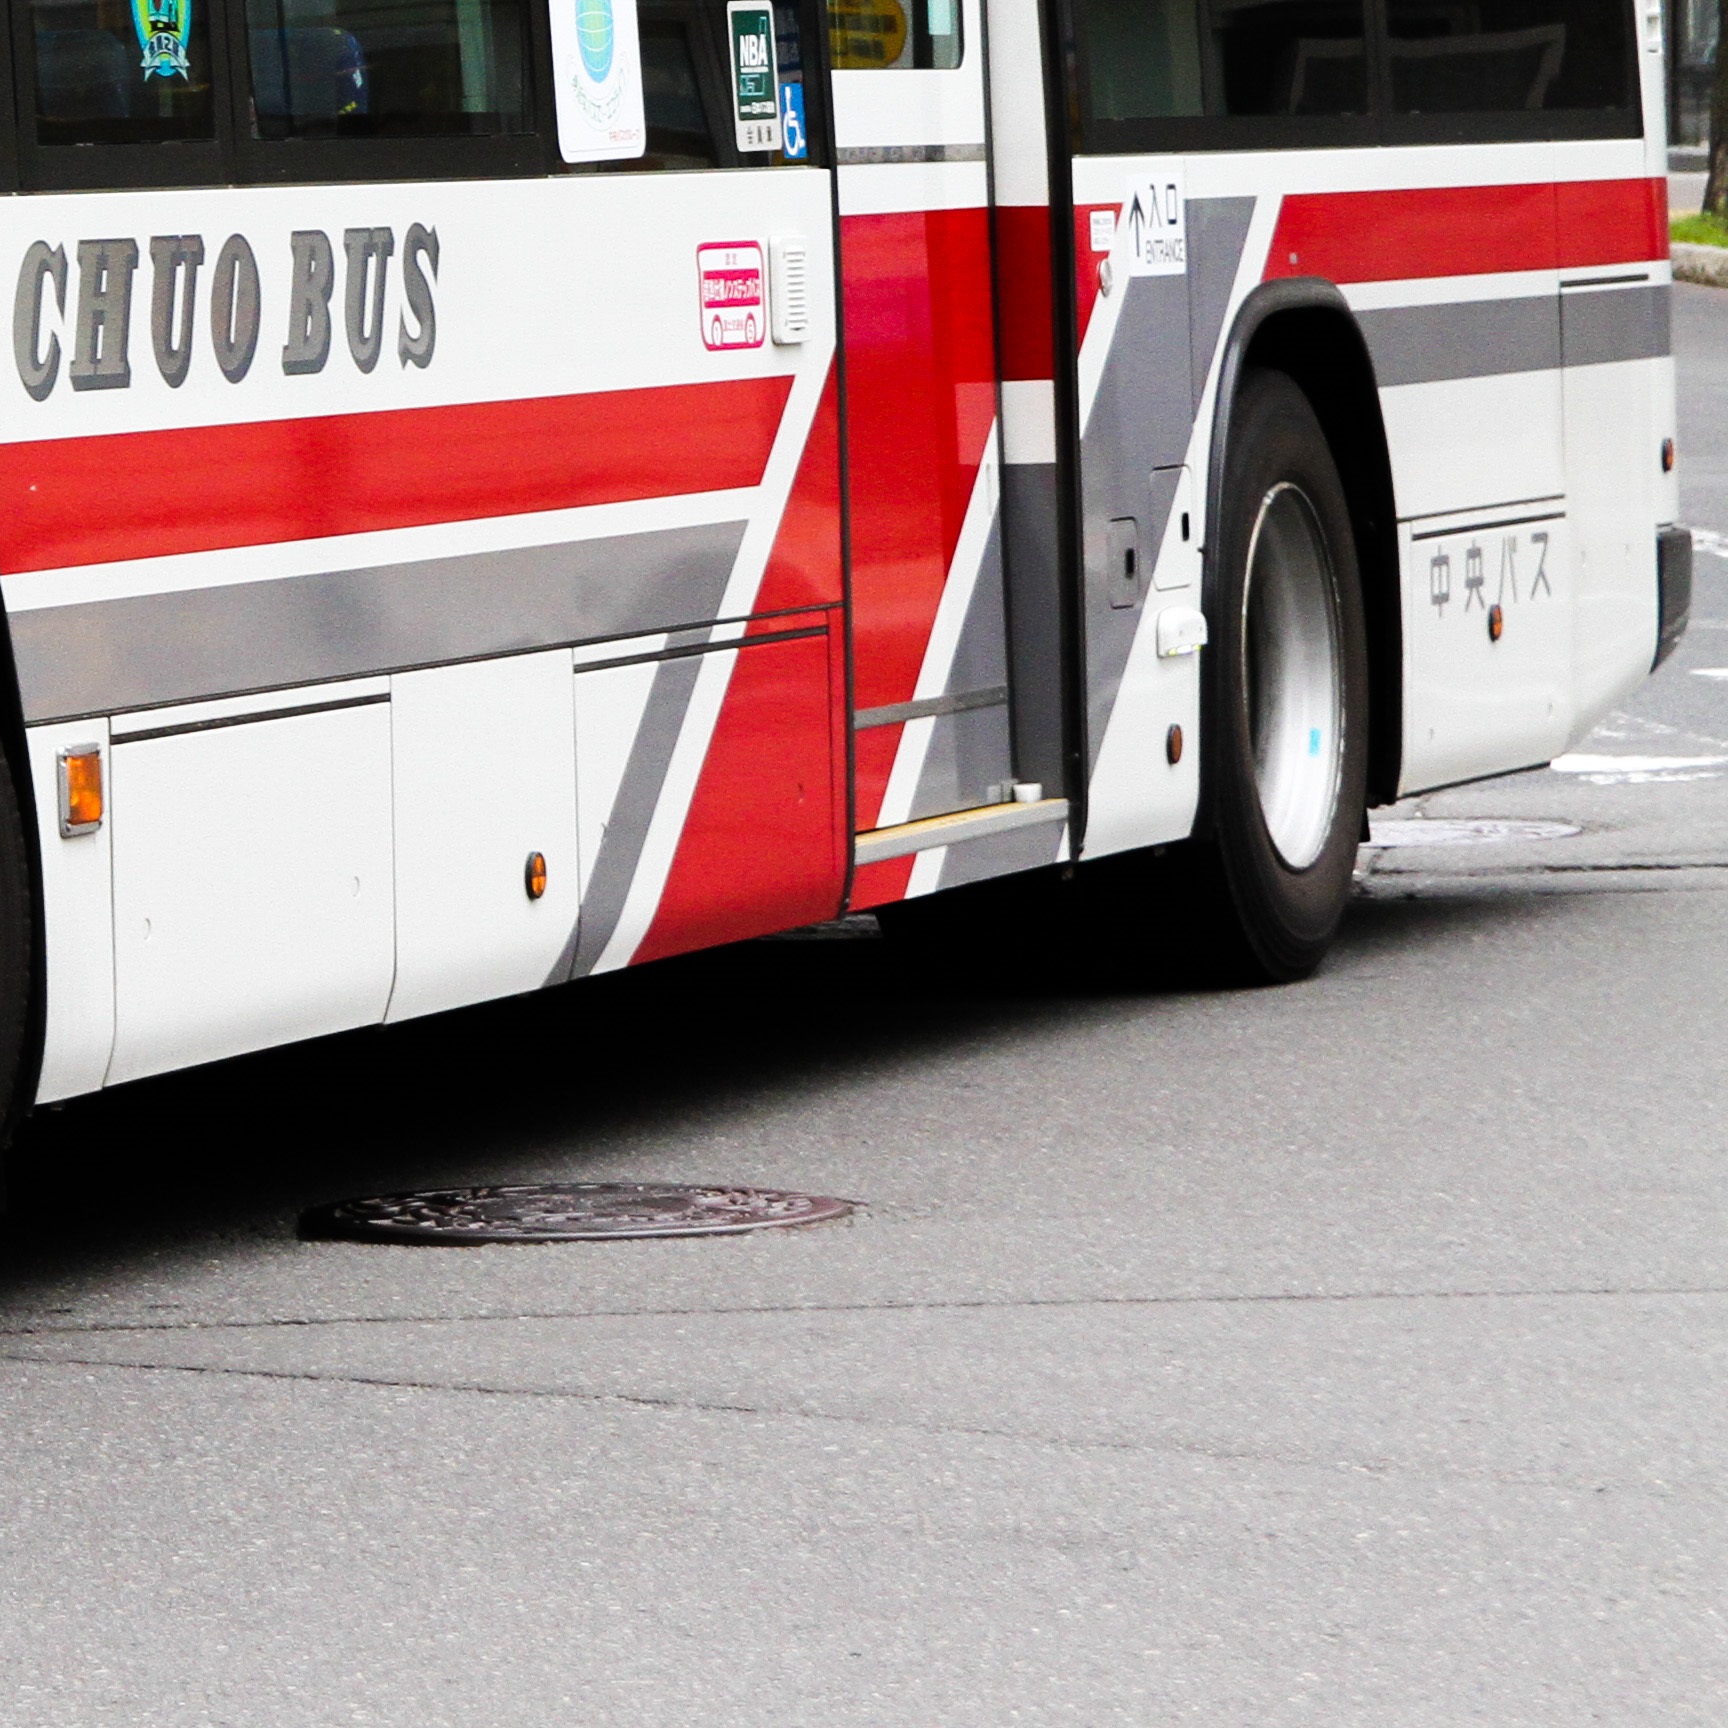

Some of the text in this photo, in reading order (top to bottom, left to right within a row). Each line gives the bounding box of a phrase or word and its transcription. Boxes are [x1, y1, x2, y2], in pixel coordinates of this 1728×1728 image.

[740, 35, 769, 67] NBA
[1149, 182, 1178, 228] 入口
[14, 223, 440, 403] CHUO BUS
[1430, 532, 1551, 617] 中央バス
